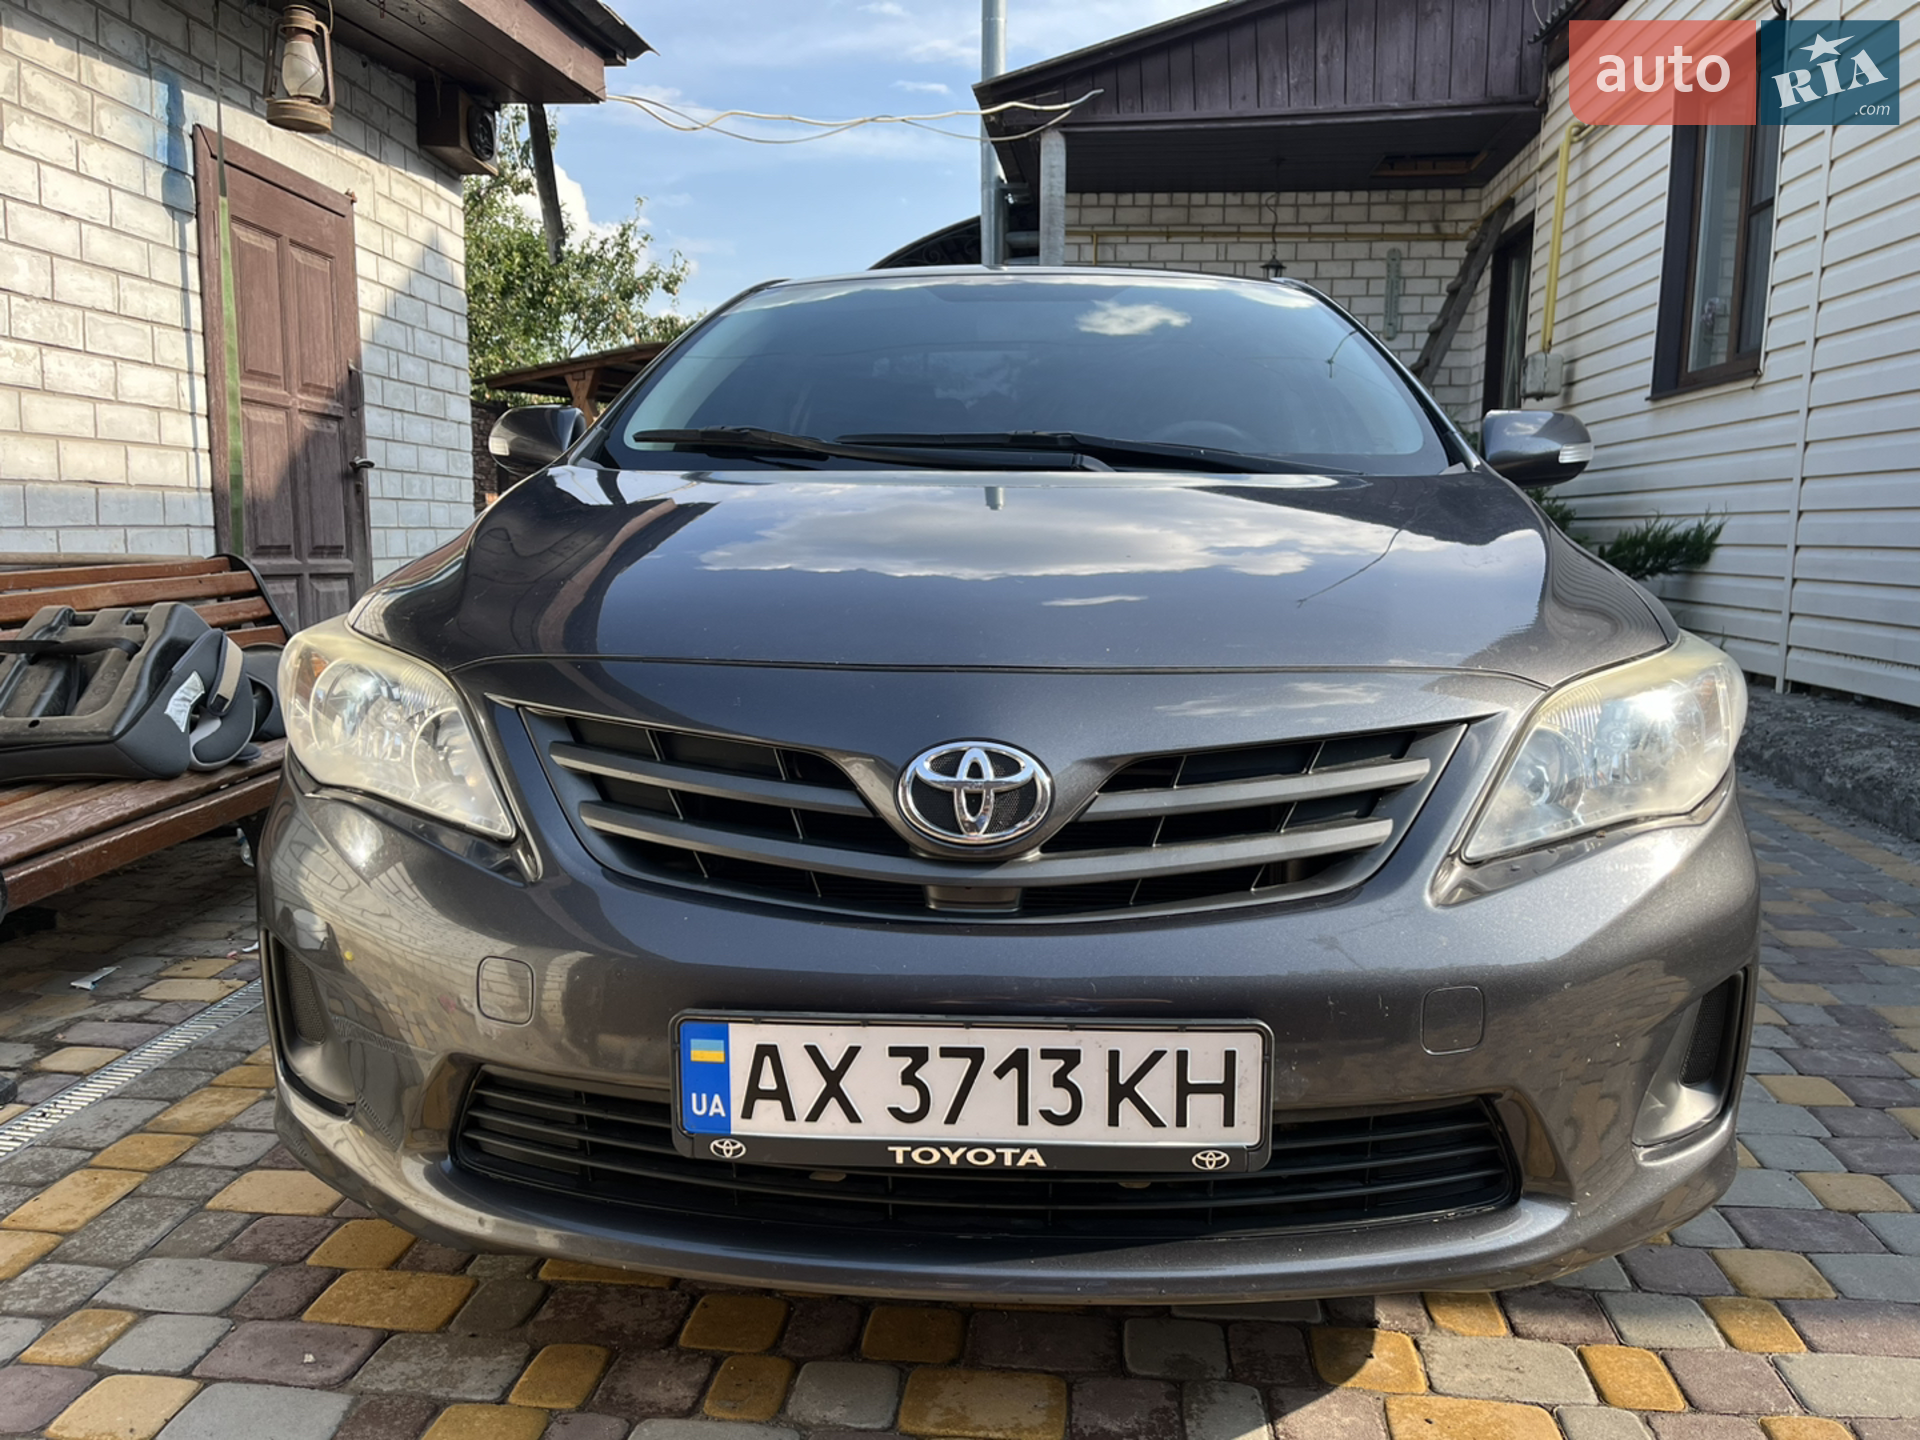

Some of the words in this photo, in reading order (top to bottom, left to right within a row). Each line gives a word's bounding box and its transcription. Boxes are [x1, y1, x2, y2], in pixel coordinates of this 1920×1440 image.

[741, 1044, 863, 1123] AX
[887, 1046, 1083, 1126] 3713
[1108, 1049, 1237, 1128] KH
[691, 1094, 726, 1117] UA
[888, 1146, 1046, 1168] TOYOTA
